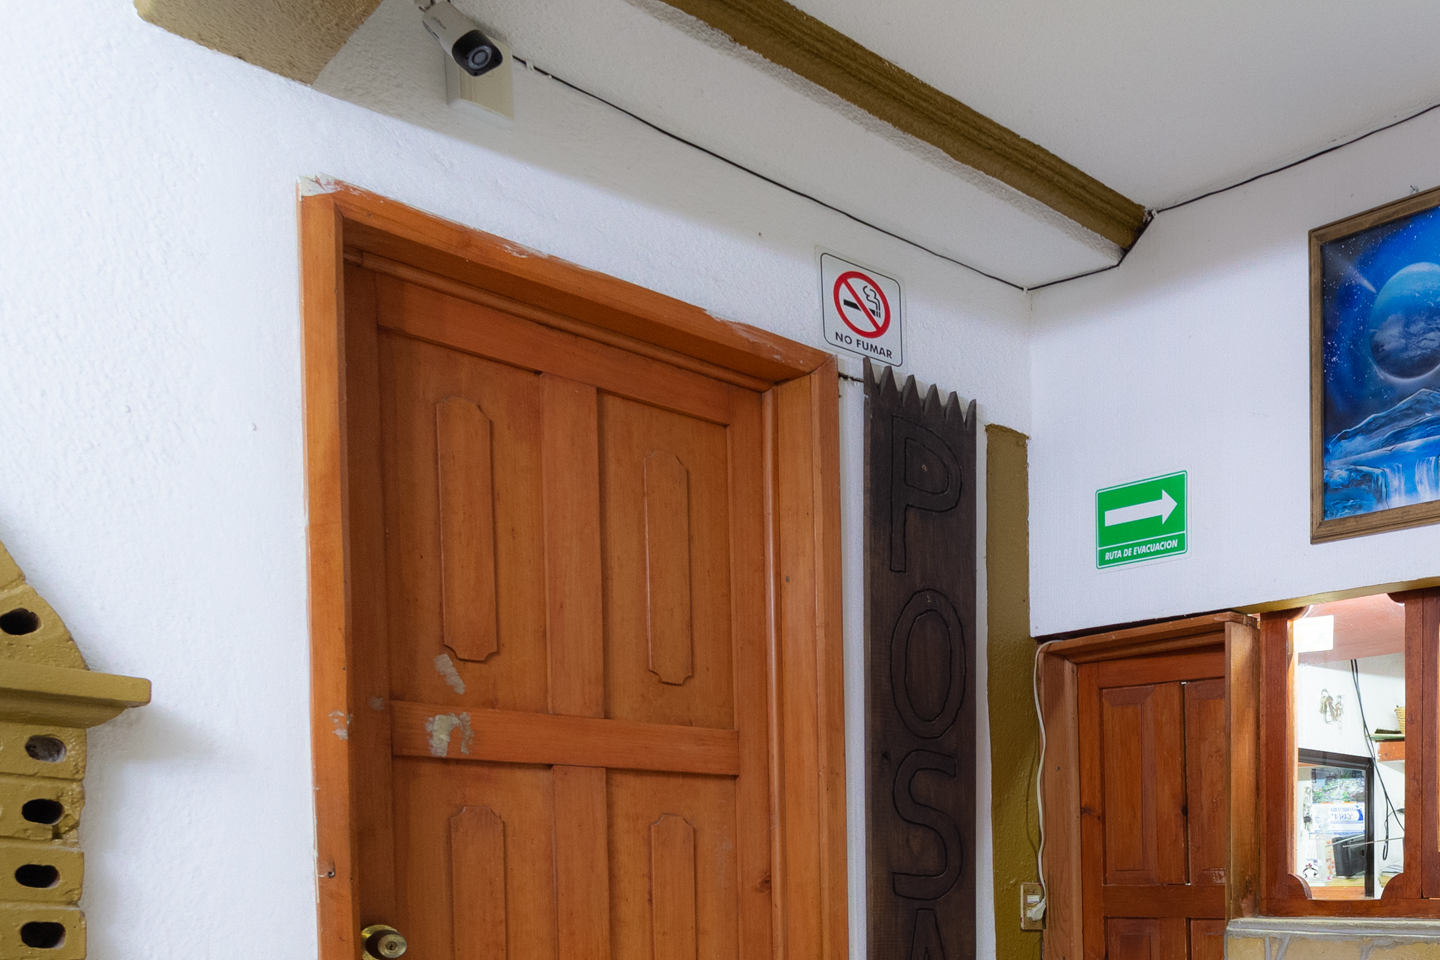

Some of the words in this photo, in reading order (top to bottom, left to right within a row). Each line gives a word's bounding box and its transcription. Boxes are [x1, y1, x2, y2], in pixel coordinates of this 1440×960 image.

[836, 332, 852, 345] NO
[857, 339, 892, 359] FUMAR
[1105, 550, 1122, 560] RUTA
[1123, 548, 1132, 557] DE
[1133, 539, 1178, 555] EVACUACION
